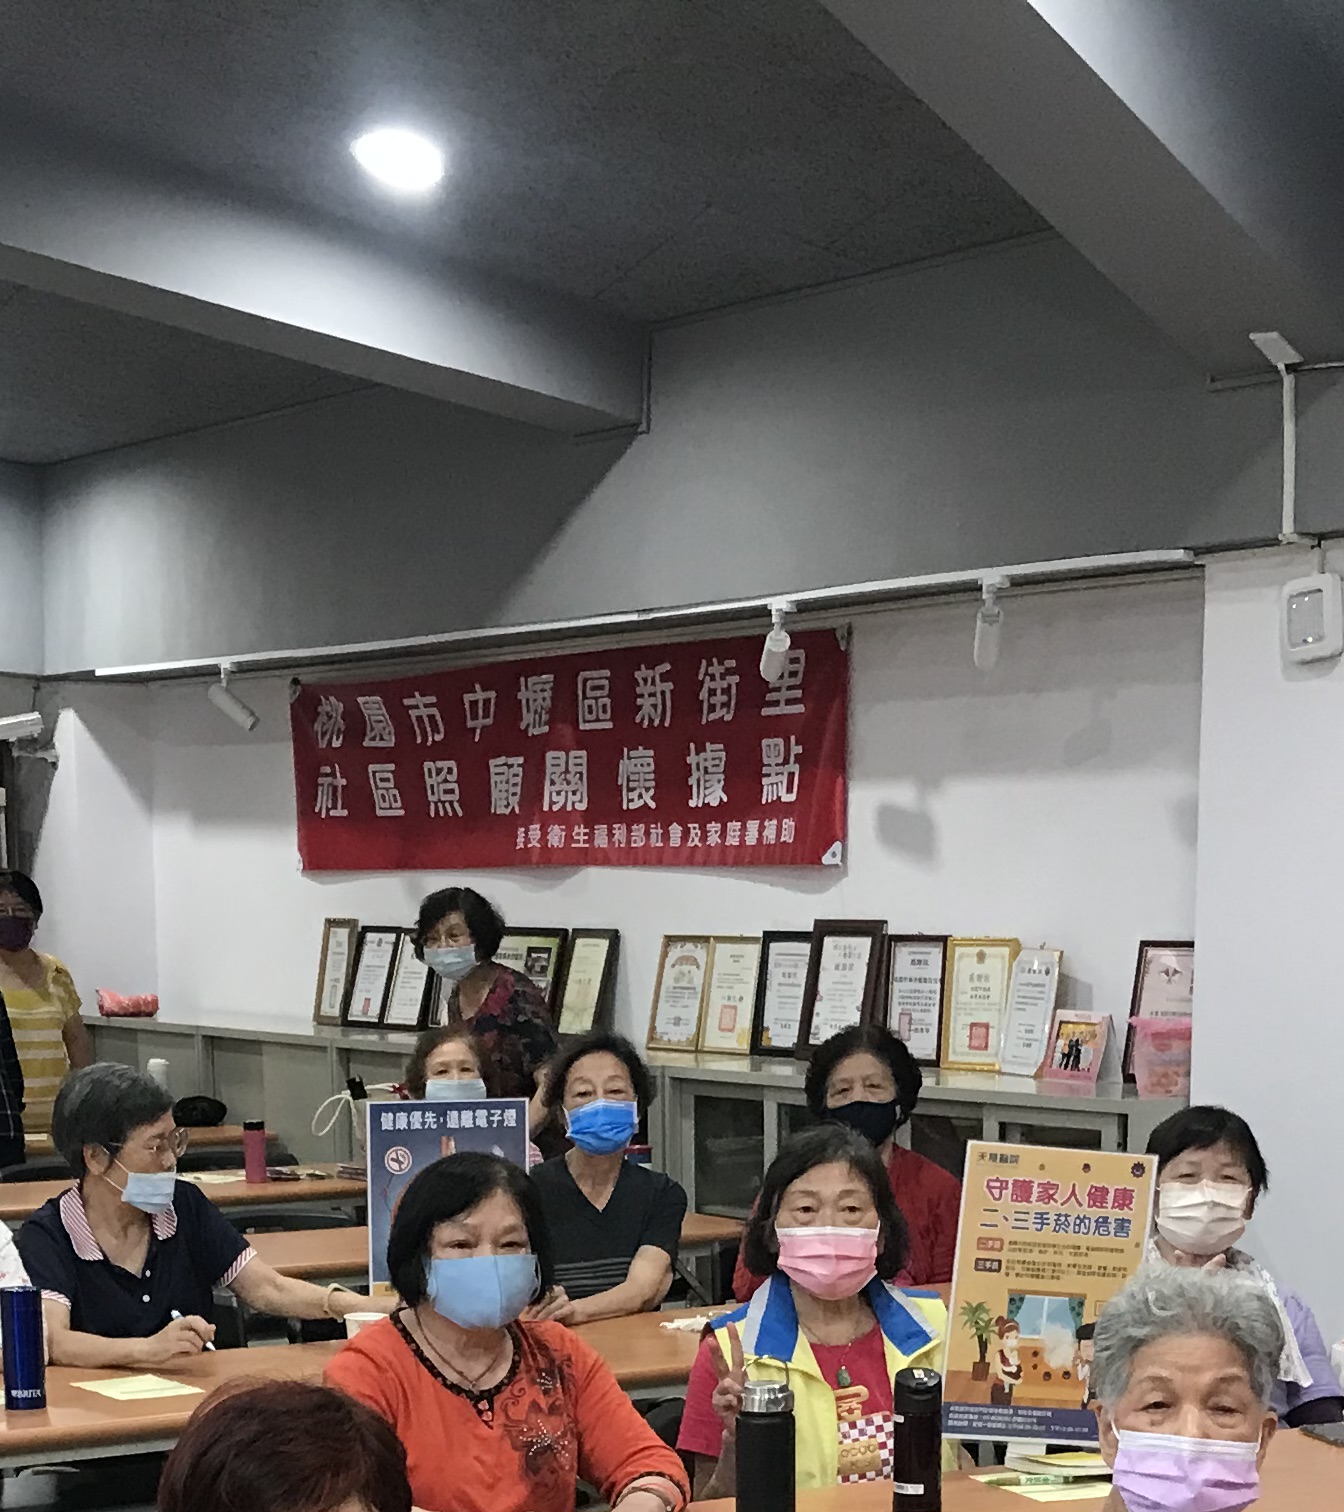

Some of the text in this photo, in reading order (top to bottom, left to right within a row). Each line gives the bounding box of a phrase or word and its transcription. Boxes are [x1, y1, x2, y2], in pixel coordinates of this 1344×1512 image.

[313, 648, 806, 748] 桃園市中壢區新街里
[313, 734, 804, 819] 社區照顧關懷據點
[979, 1208, 1132, 1239] 二、三手菸的危害
[985, 1176, 1136, 1212] 守護家人健康
